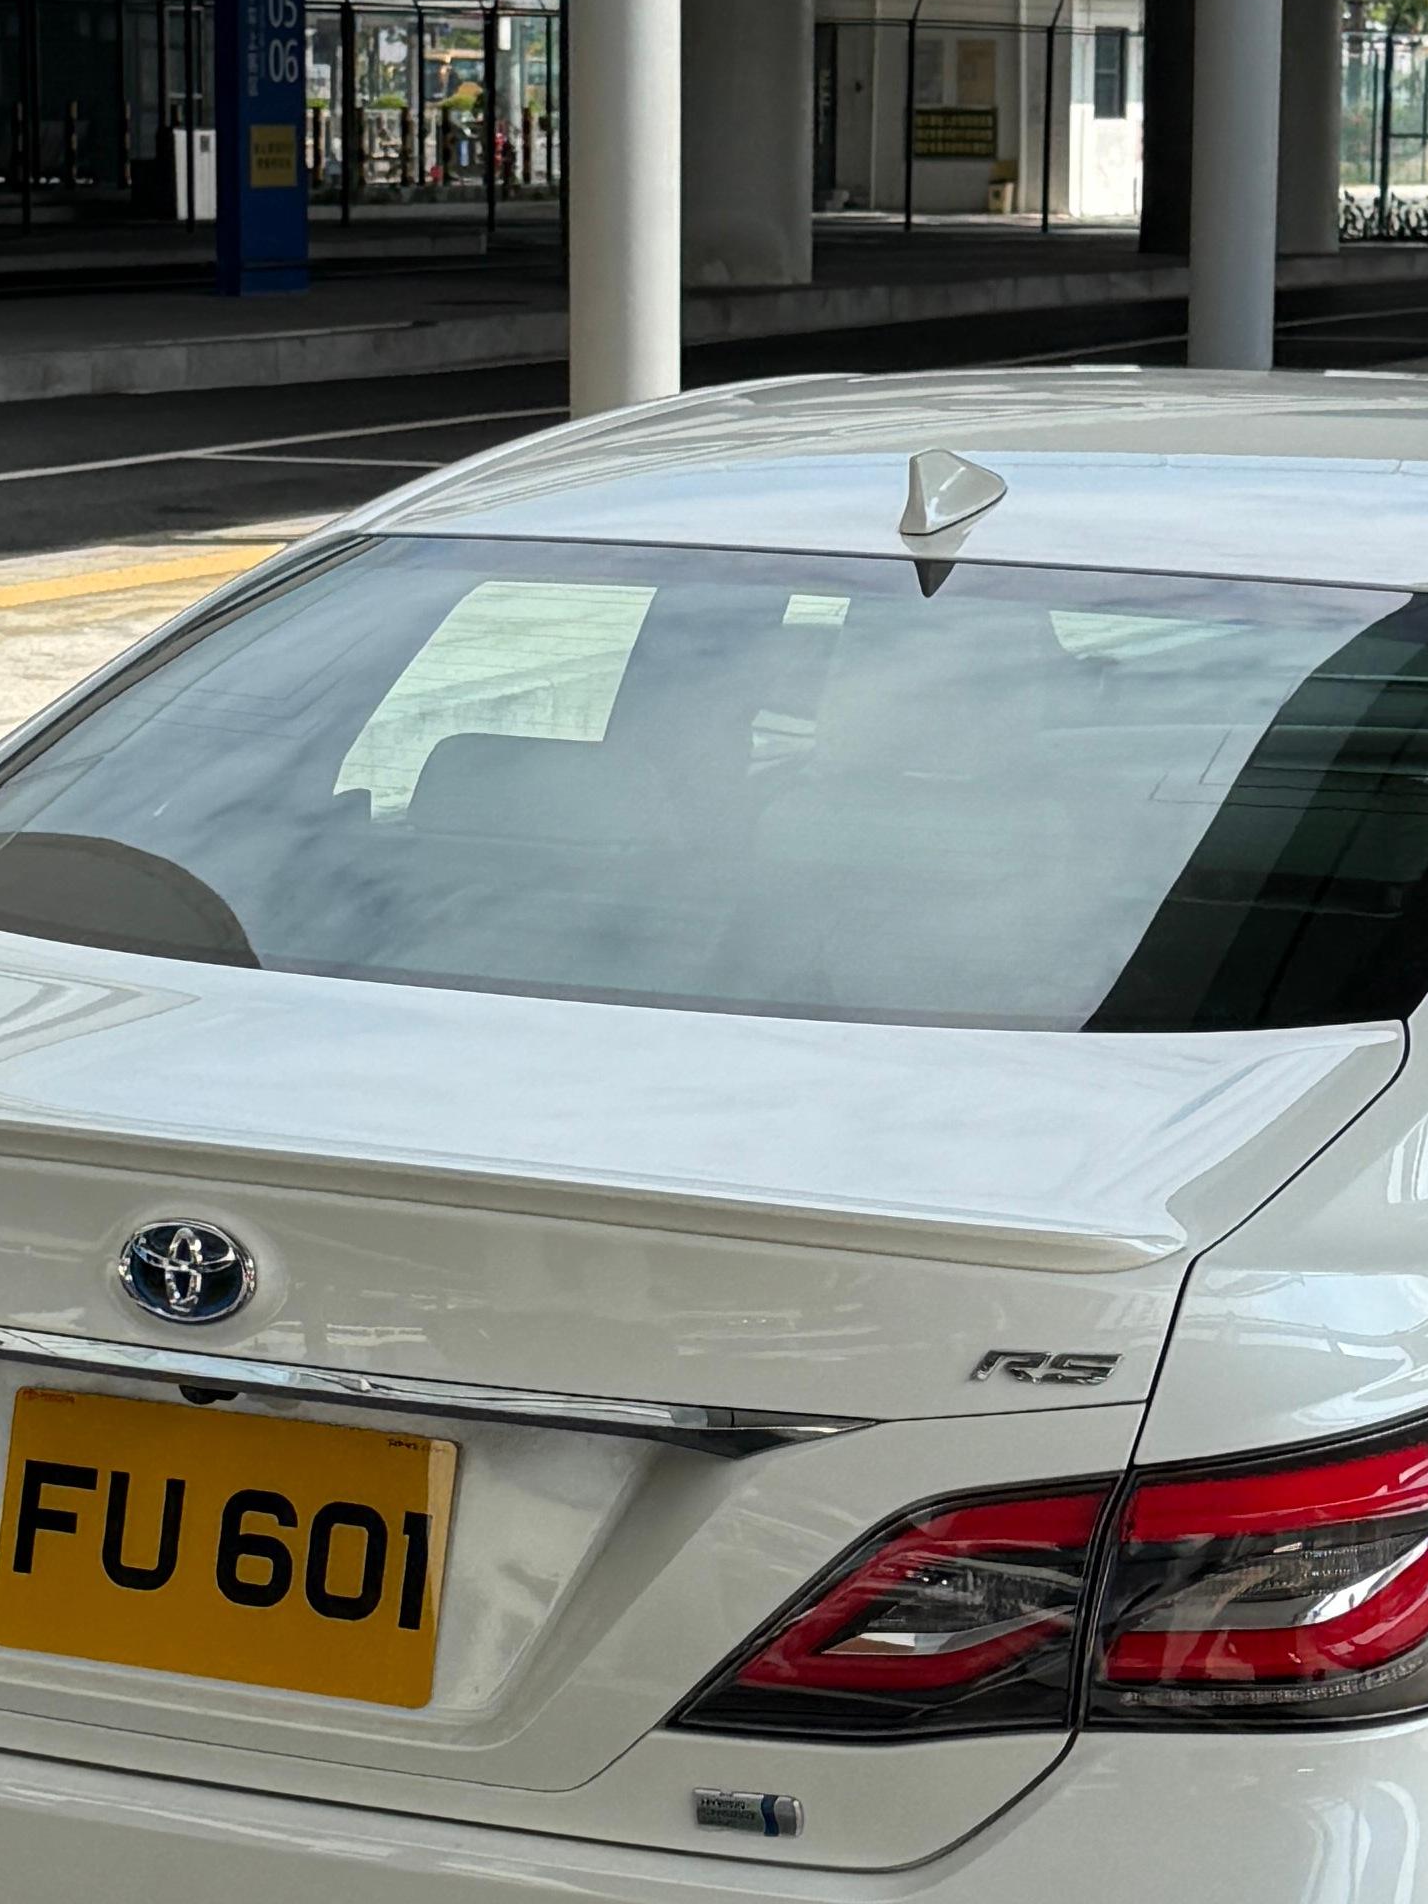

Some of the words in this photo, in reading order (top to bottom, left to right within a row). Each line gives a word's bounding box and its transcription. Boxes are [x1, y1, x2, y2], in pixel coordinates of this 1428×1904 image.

[269, 38, 298, 83] 06
[970, 1349, 1123, 1385] RS
[12, 1459, 186, 1592] FU
[215, 1488, 432, 1631] 601
